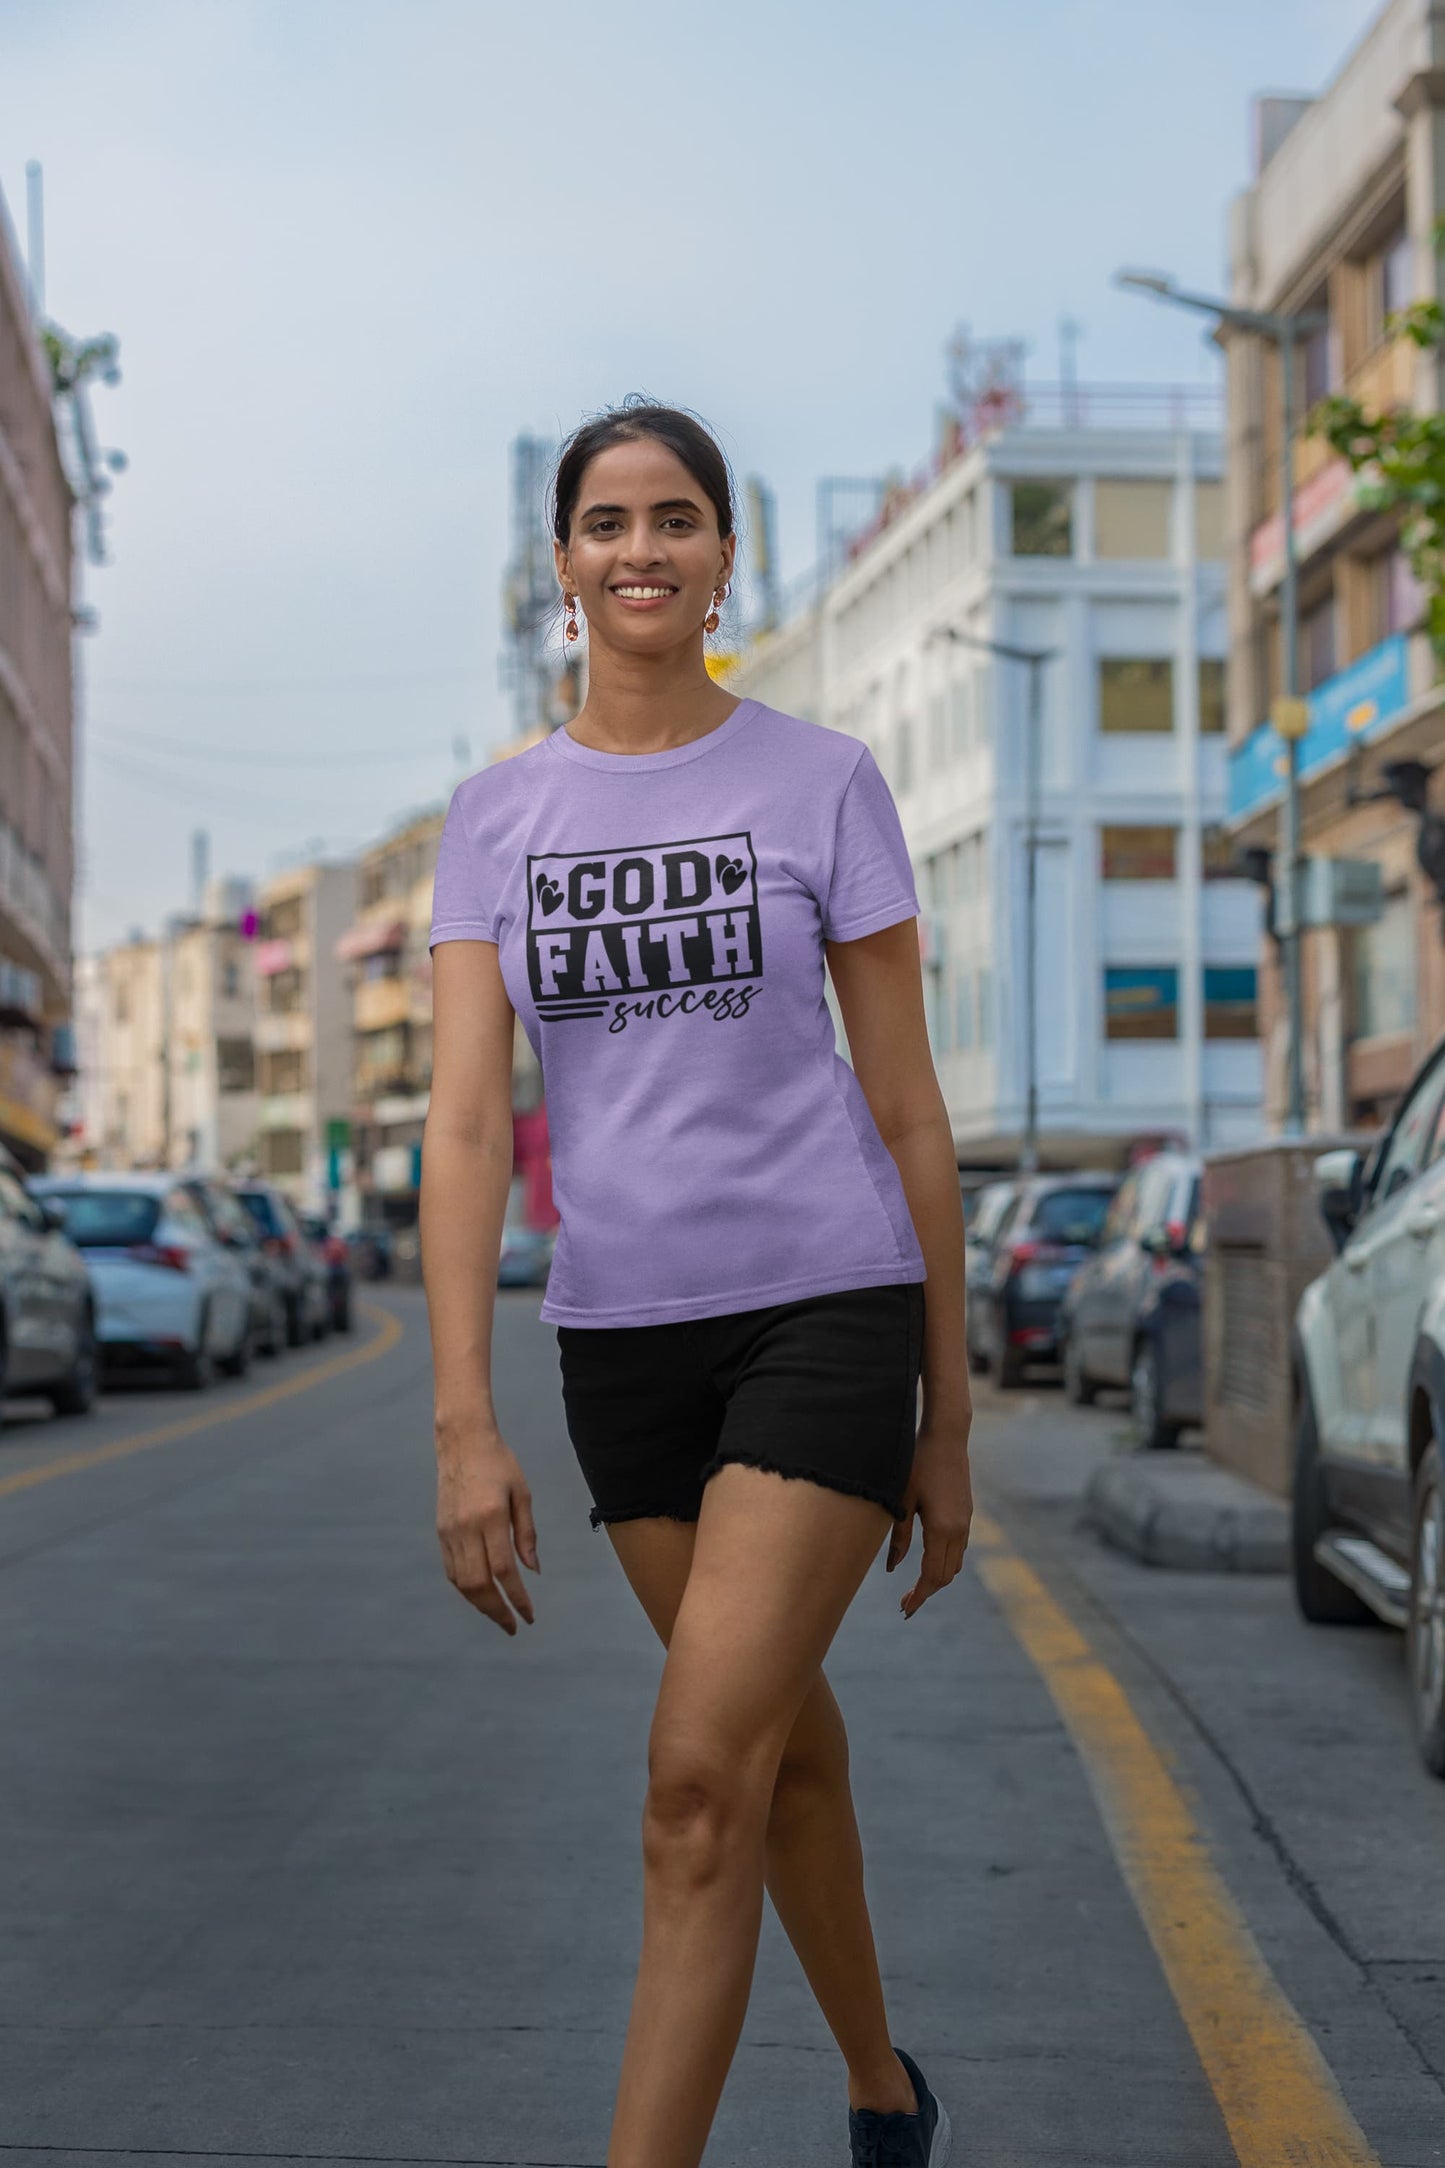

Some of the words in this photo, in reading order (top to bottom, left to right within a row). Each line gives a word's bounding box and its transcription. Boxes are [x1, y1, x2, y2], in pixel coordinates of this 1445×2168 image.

[568, 850, 712, 920] GOD
[536, 911, 753, 995] FAITH
[609, 985, 763, 1034] success
